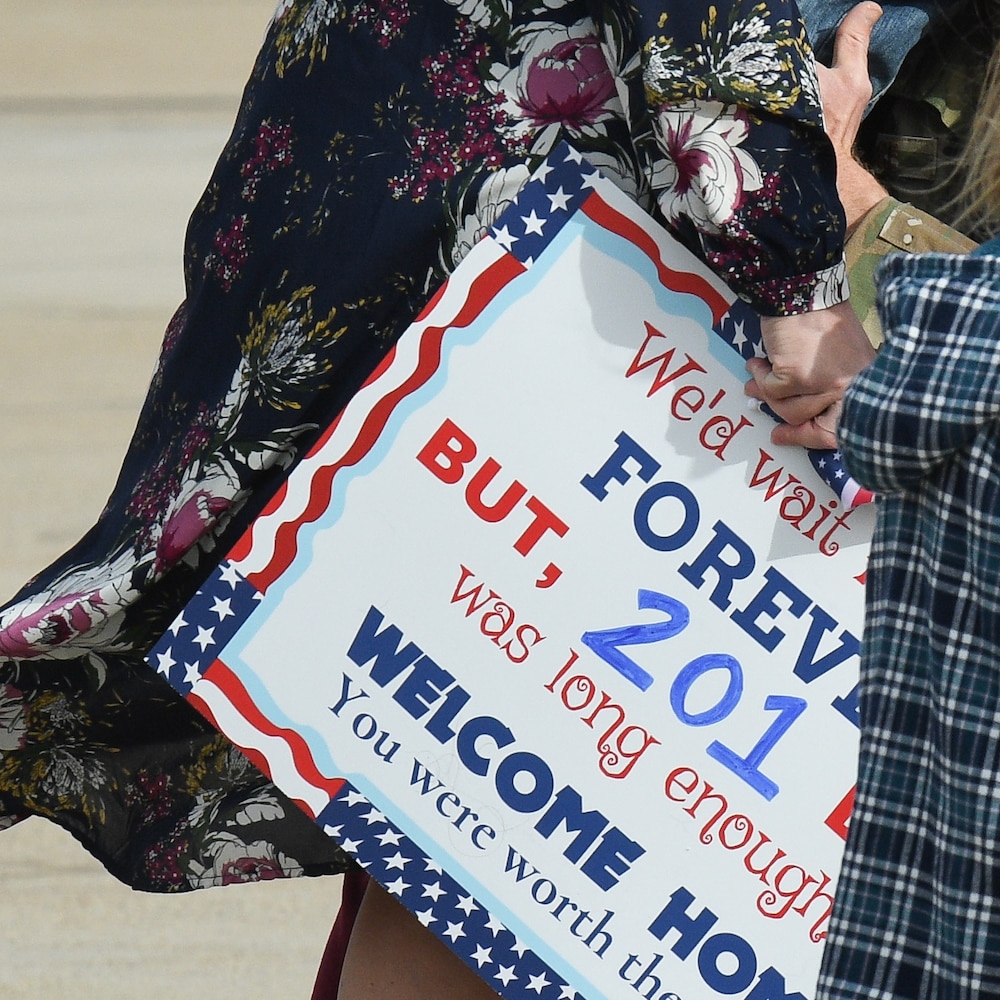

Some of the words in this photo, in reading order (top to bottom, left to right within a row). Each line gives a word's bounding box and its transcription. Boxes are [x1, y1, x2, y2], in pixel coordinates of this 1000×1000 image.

[624, 320, 754, 461] We'd
[748, 447, 855, 556] wait
[346, 605, 646, 892] WELCOME
[415, 418, 569, 590] BUT,
[581, 588, 808, 801] 201
[450, 564, 546, 664] was
[544, 648, 662, 778] long
[327, 672, 402, 764] You
[408, 757, 497, 851] were
[502, 845, 615, 959] worth
